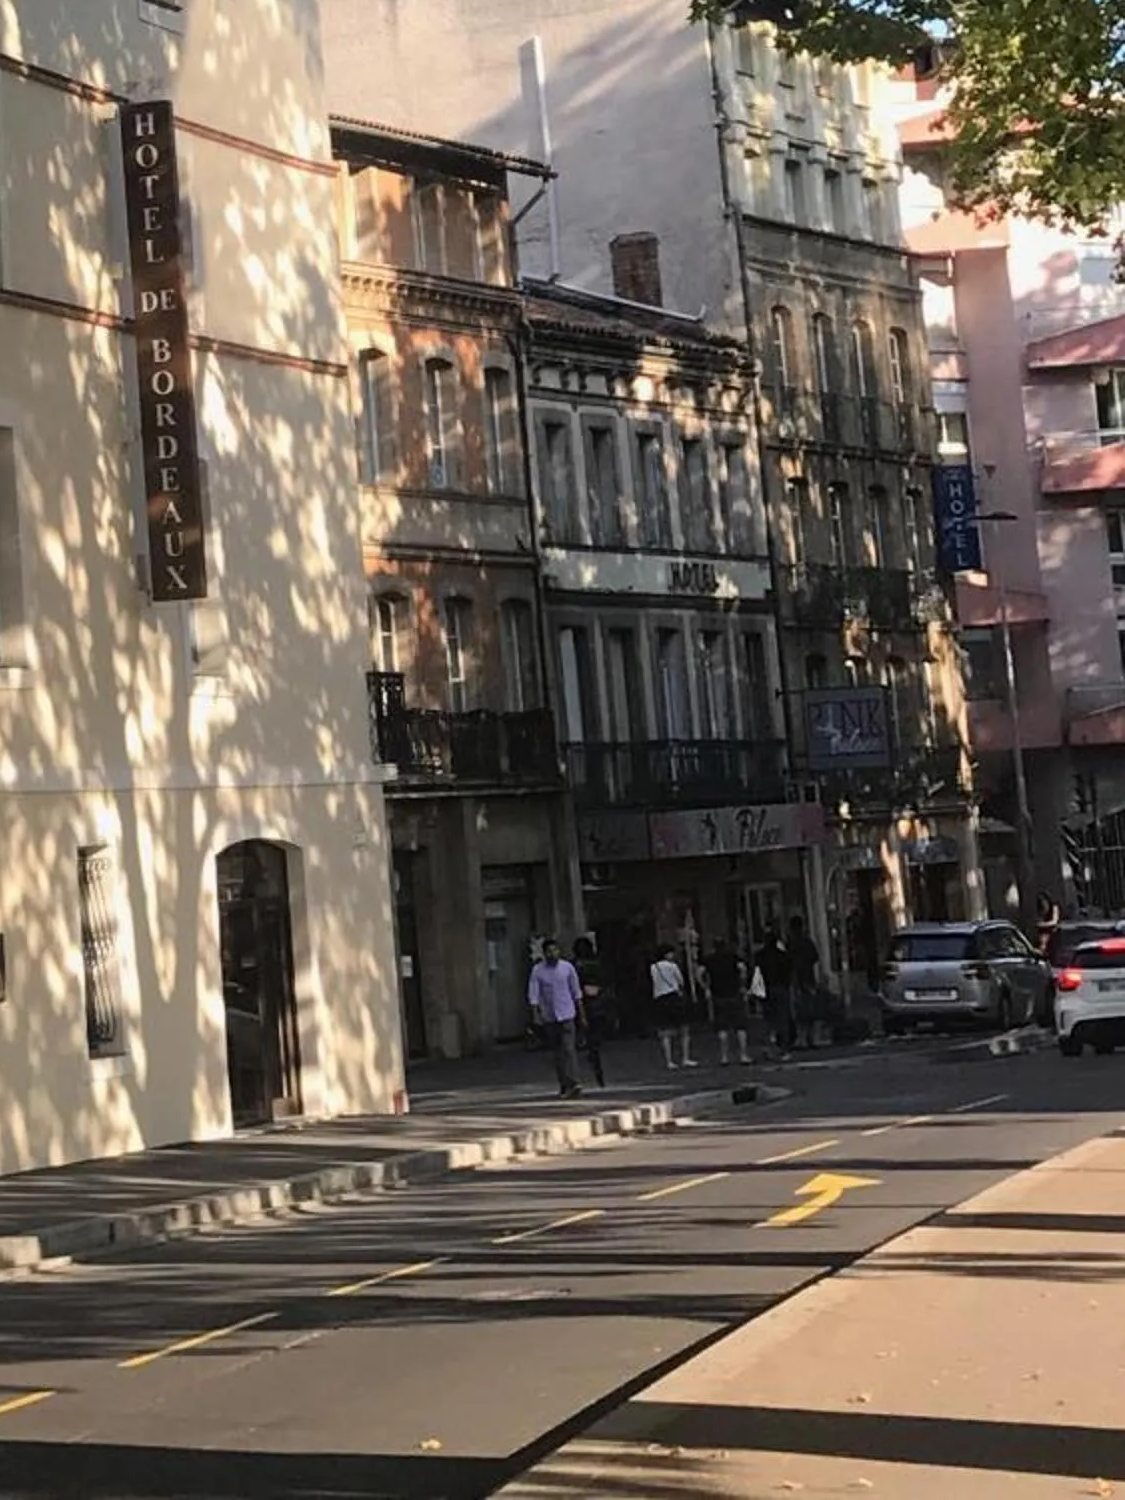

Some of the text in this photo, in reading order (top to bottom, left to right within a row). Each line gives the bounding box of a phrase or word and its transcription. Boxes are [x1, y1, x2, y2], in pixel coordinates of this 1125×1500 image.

[134, 113, 188, 591] HOTEL DE BORDEAUX
[949, 483, 969, 567] HOTEL
